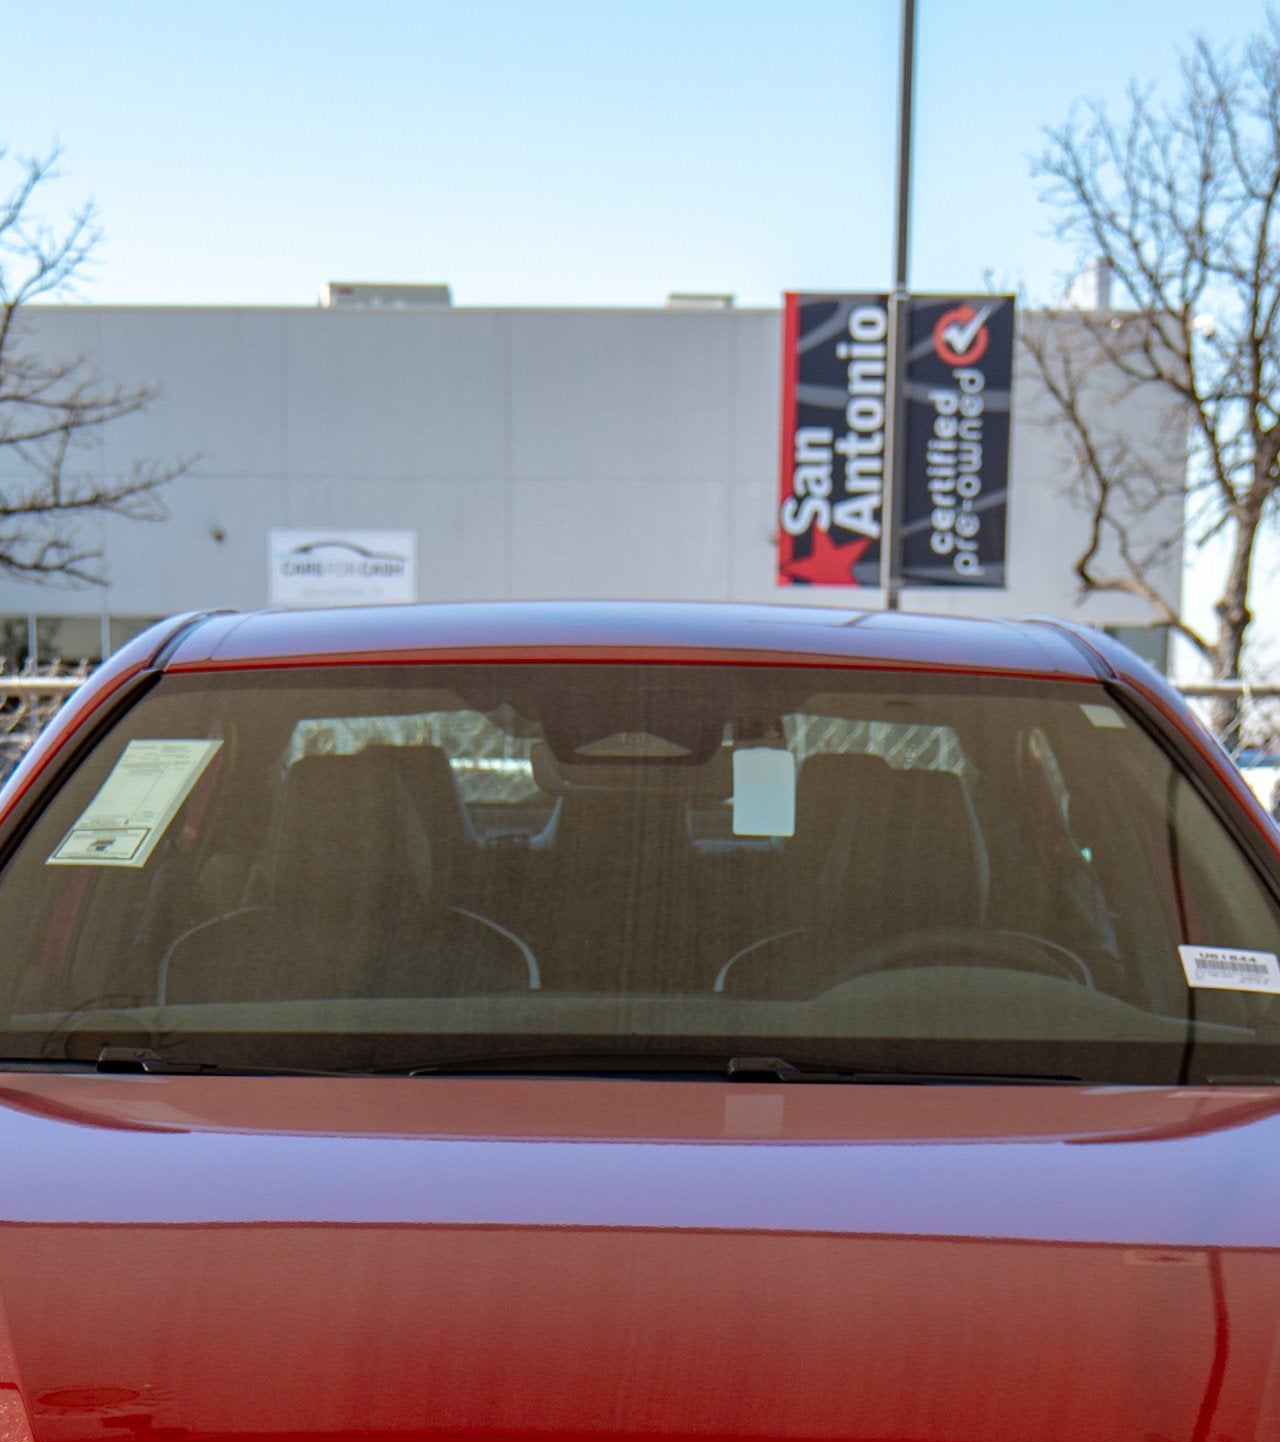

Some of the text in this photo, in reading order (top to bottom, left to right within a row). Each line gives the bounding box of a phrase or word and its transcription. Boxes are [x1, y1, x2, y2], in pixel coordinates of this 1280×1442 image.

[781, 427, 833, 536] San
[833, 304, 890, 539] Antonio
[926, 389, 959, 554] certified
[952, 367, 986, 577] pre-owned
